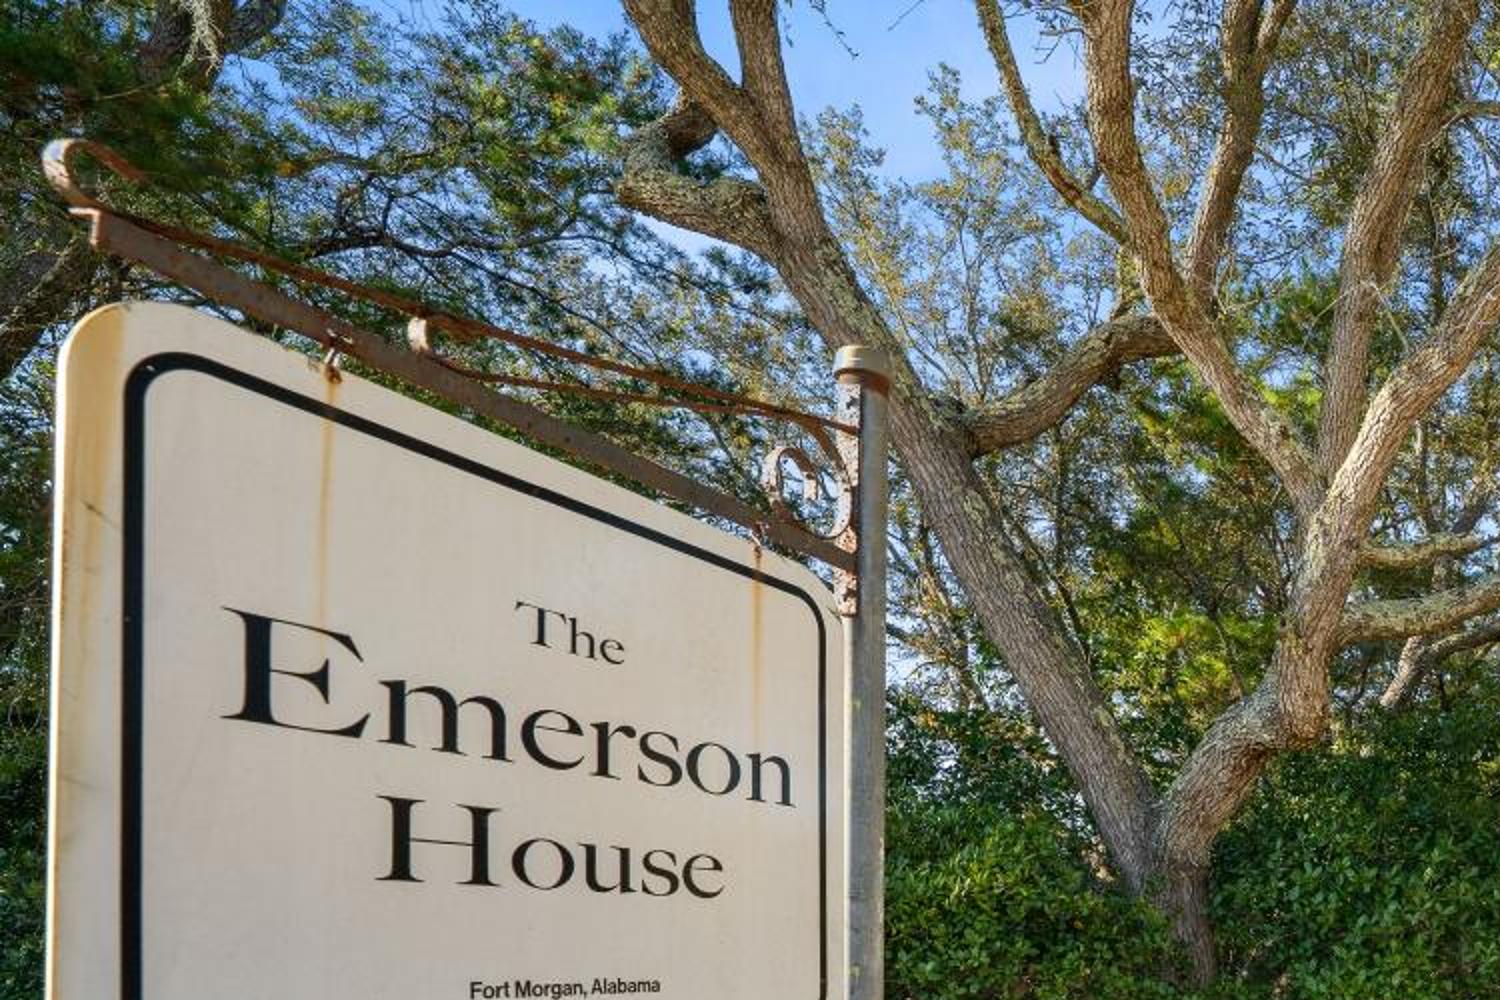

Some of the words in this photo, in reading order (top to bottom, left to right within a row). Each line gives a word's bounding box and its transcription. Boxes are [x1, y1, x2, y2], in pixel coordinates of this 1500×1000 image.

[514, 601, 626, 666] The
[220, 606, 798, 809] Emerson
[375, 794, 725, 899] House
[469, 981, 510, 1000] Fort
[514, 979, 588, 1000] Morgan,
[591, 977, 661, 995] Alabama
